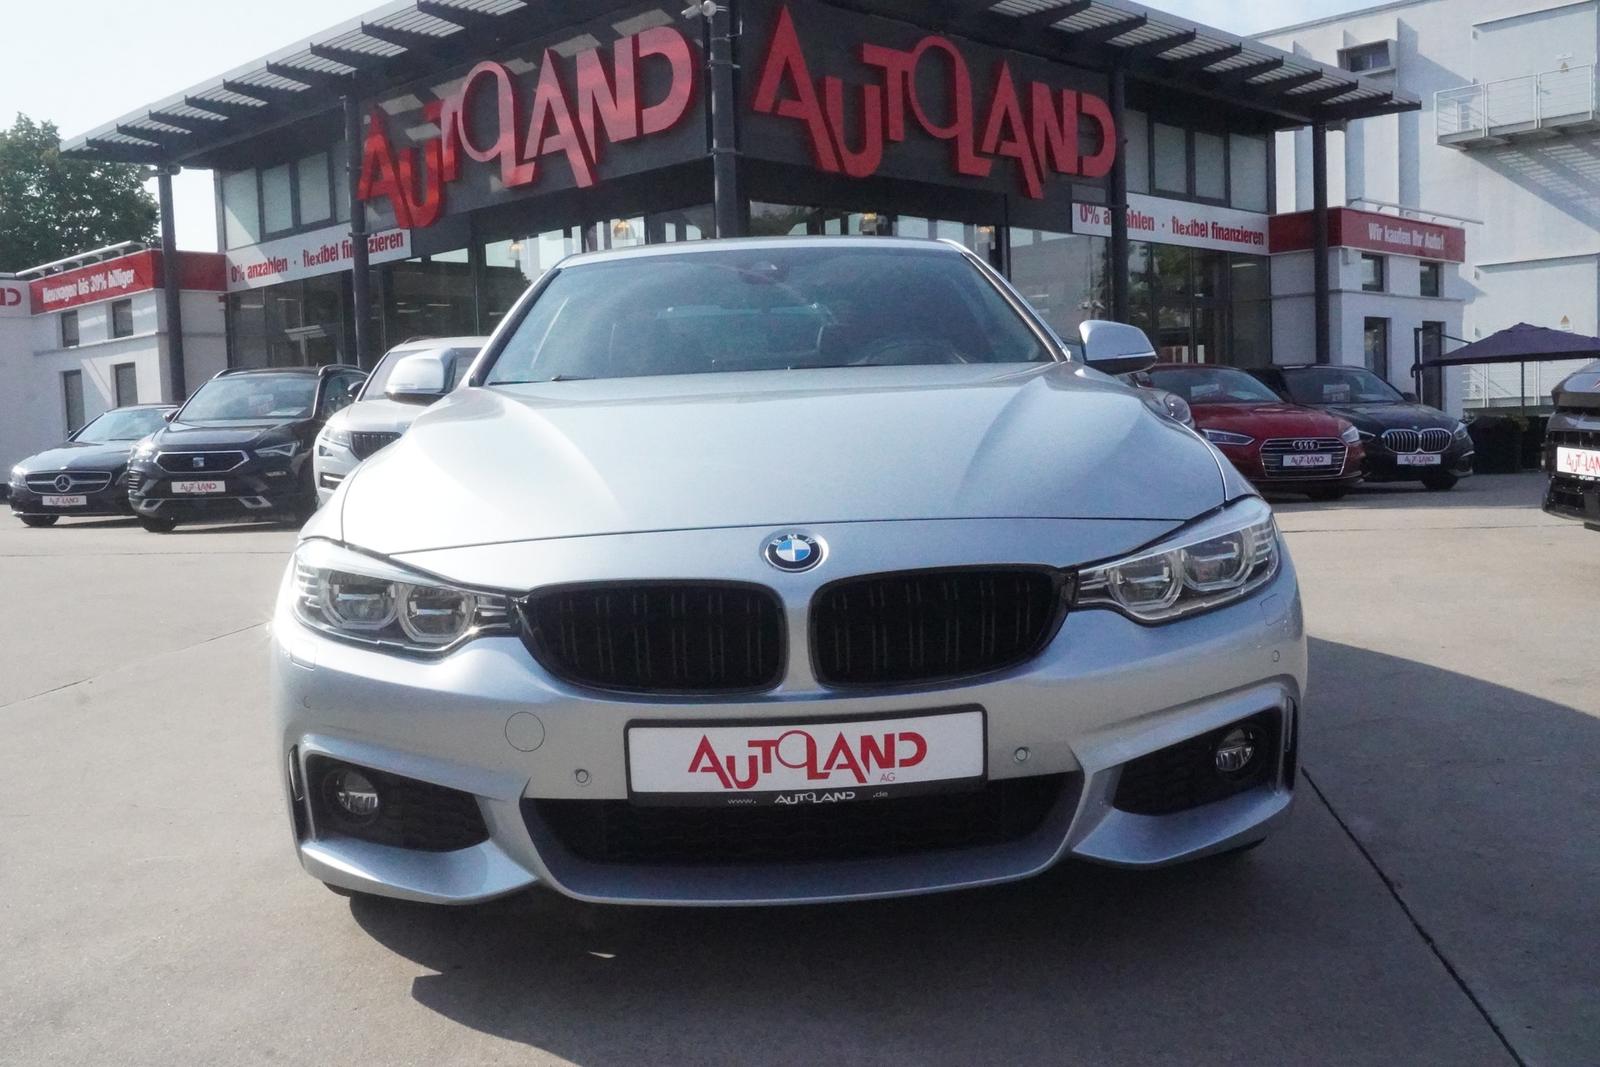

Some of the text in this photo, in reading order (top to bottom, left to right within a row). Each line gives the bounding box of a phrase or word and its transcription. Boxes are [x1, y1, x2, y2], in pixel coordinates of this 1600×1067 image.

[752, 4, 1116, 199] AUTOLAND
[358, 26, 693, 228] AUTOLAND
[1080, 204, 1264, 246] 0% aahlen flexibel finanzieren
[231, 232, 404, 282] 0% anzahlen flexibel fizieren
[771, 534, 817, 546] BMW
[688, 730, 927, 789] AUTOLAND
[880, 772, 896, 783] AG
[774, 791, 856, 805] AUTOLAND
